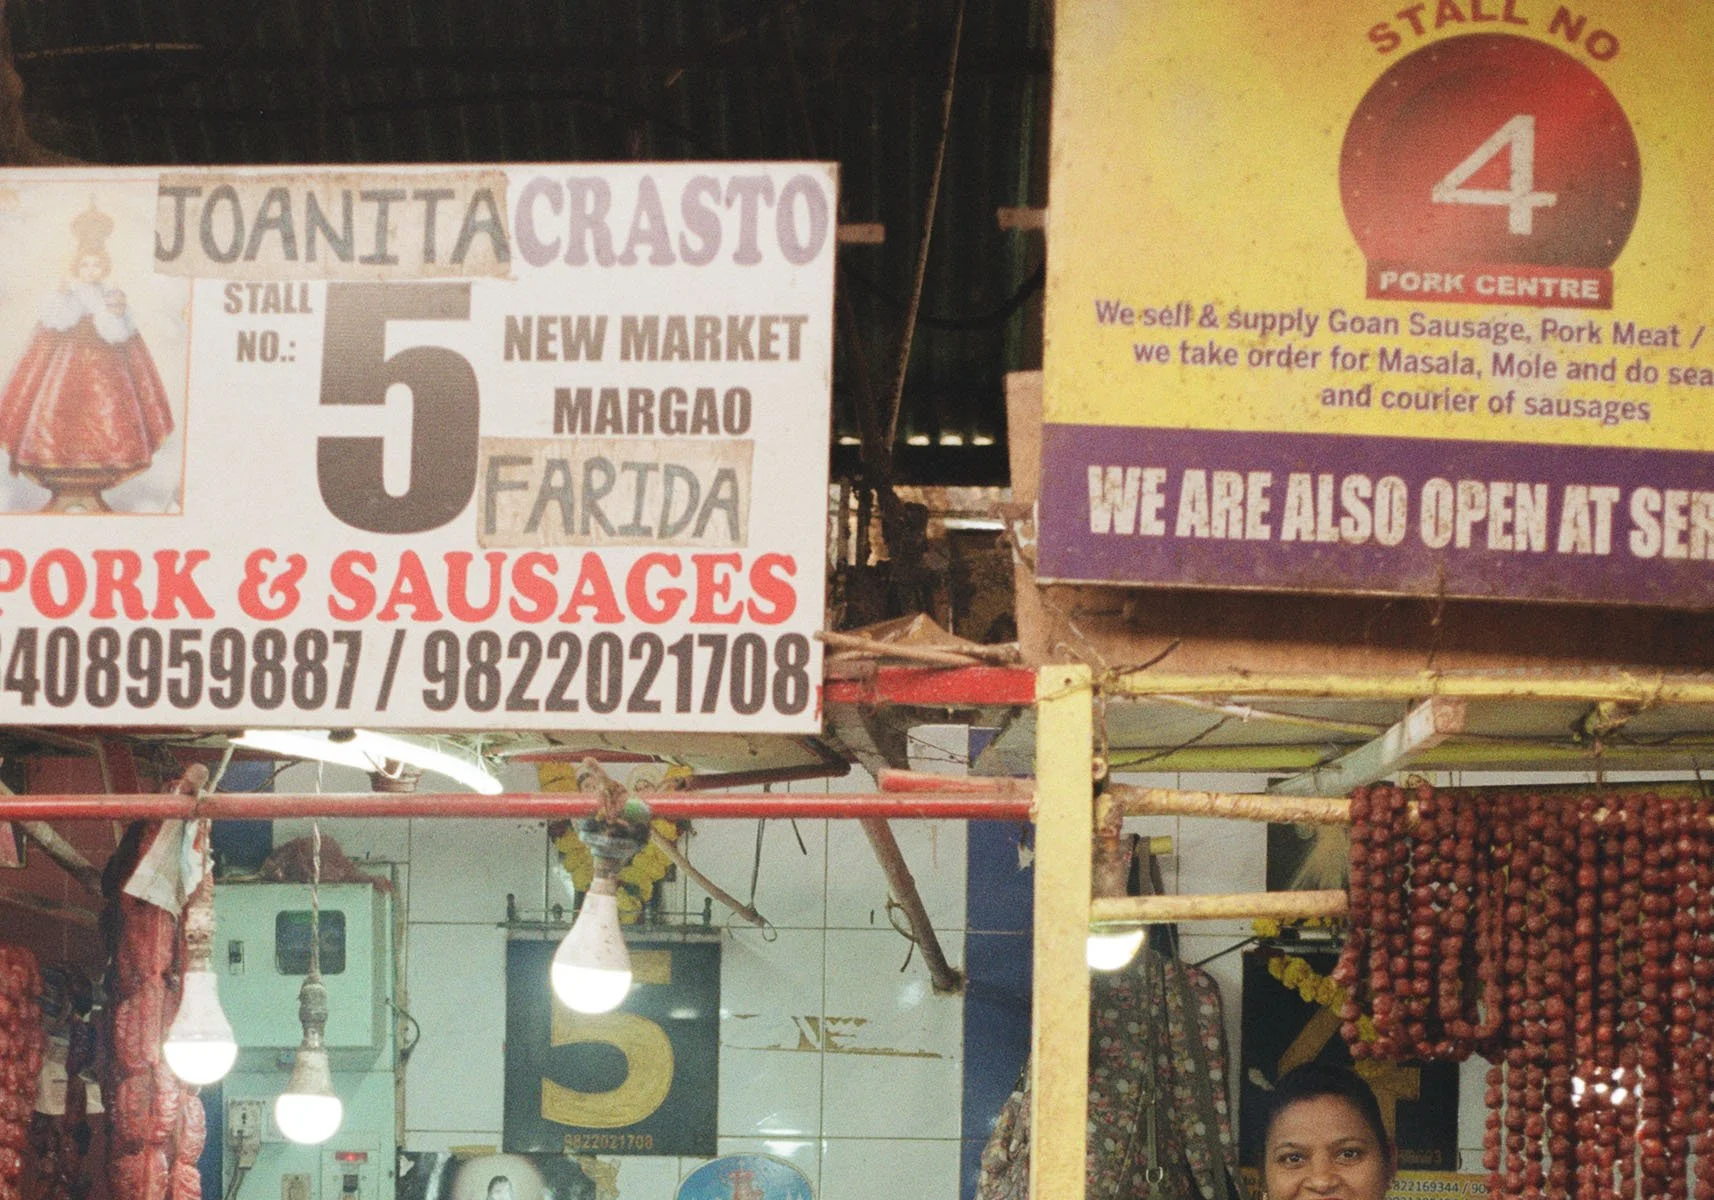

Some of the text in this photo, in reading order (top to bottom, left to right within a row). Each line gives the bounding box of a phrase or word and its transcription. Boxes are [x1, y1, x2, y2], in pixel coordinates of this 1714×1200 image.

[1367, 0, 1620, 62] STALL NO
[1431, 114, 1557, 235] 4
[155, 174, 829, 267] JOANITA CRASTO
[224, 282, 312, 314] STALL
[1380, 271, 1600, 299] PORK CENTRE
[236, 331, 296, 362] NO.:
[504, 315, 808, 361] NEW MARKET
[1095, 299, 1706, 349] We sell & supply Goan Sausage, Pork Meat /
[1133, 342, 1171, 364] we
[1179, 340, 1239, 366] take
[1247, 343, 1321, 369] order
[1331, 345, 1369, 371] for
[1378, 347, 1482, 380] Masala,
[1491, 352, 1558, 379] Mole
[1566, 357, 1617, 382] and
[1625, 357, 1659, 384] do
[317, 282, 480, 535] 5
[553, 387, 752, 435] MARGAO
[1321, 384, 1651, 425] and courier of sausages
[483, 456, 742, 541] FARIDA
[1087, 465, 1167, 537] WE
[1175, 468, 1272, 541] ARE
[1281, 472, 1407, 547] ALSO
[1420, 477, 1548, 553] OPEN
[1556, 485, 1619, 556] AT
[238, 548, 308, 621] &
[327, 548, 798, 624] SAUSAGES
[0, 626, 811, 715] 408959887 / 9822021708
[541, 950, 675, 1129] 5
[1393, 1180, 1459, 1193] 822169344
